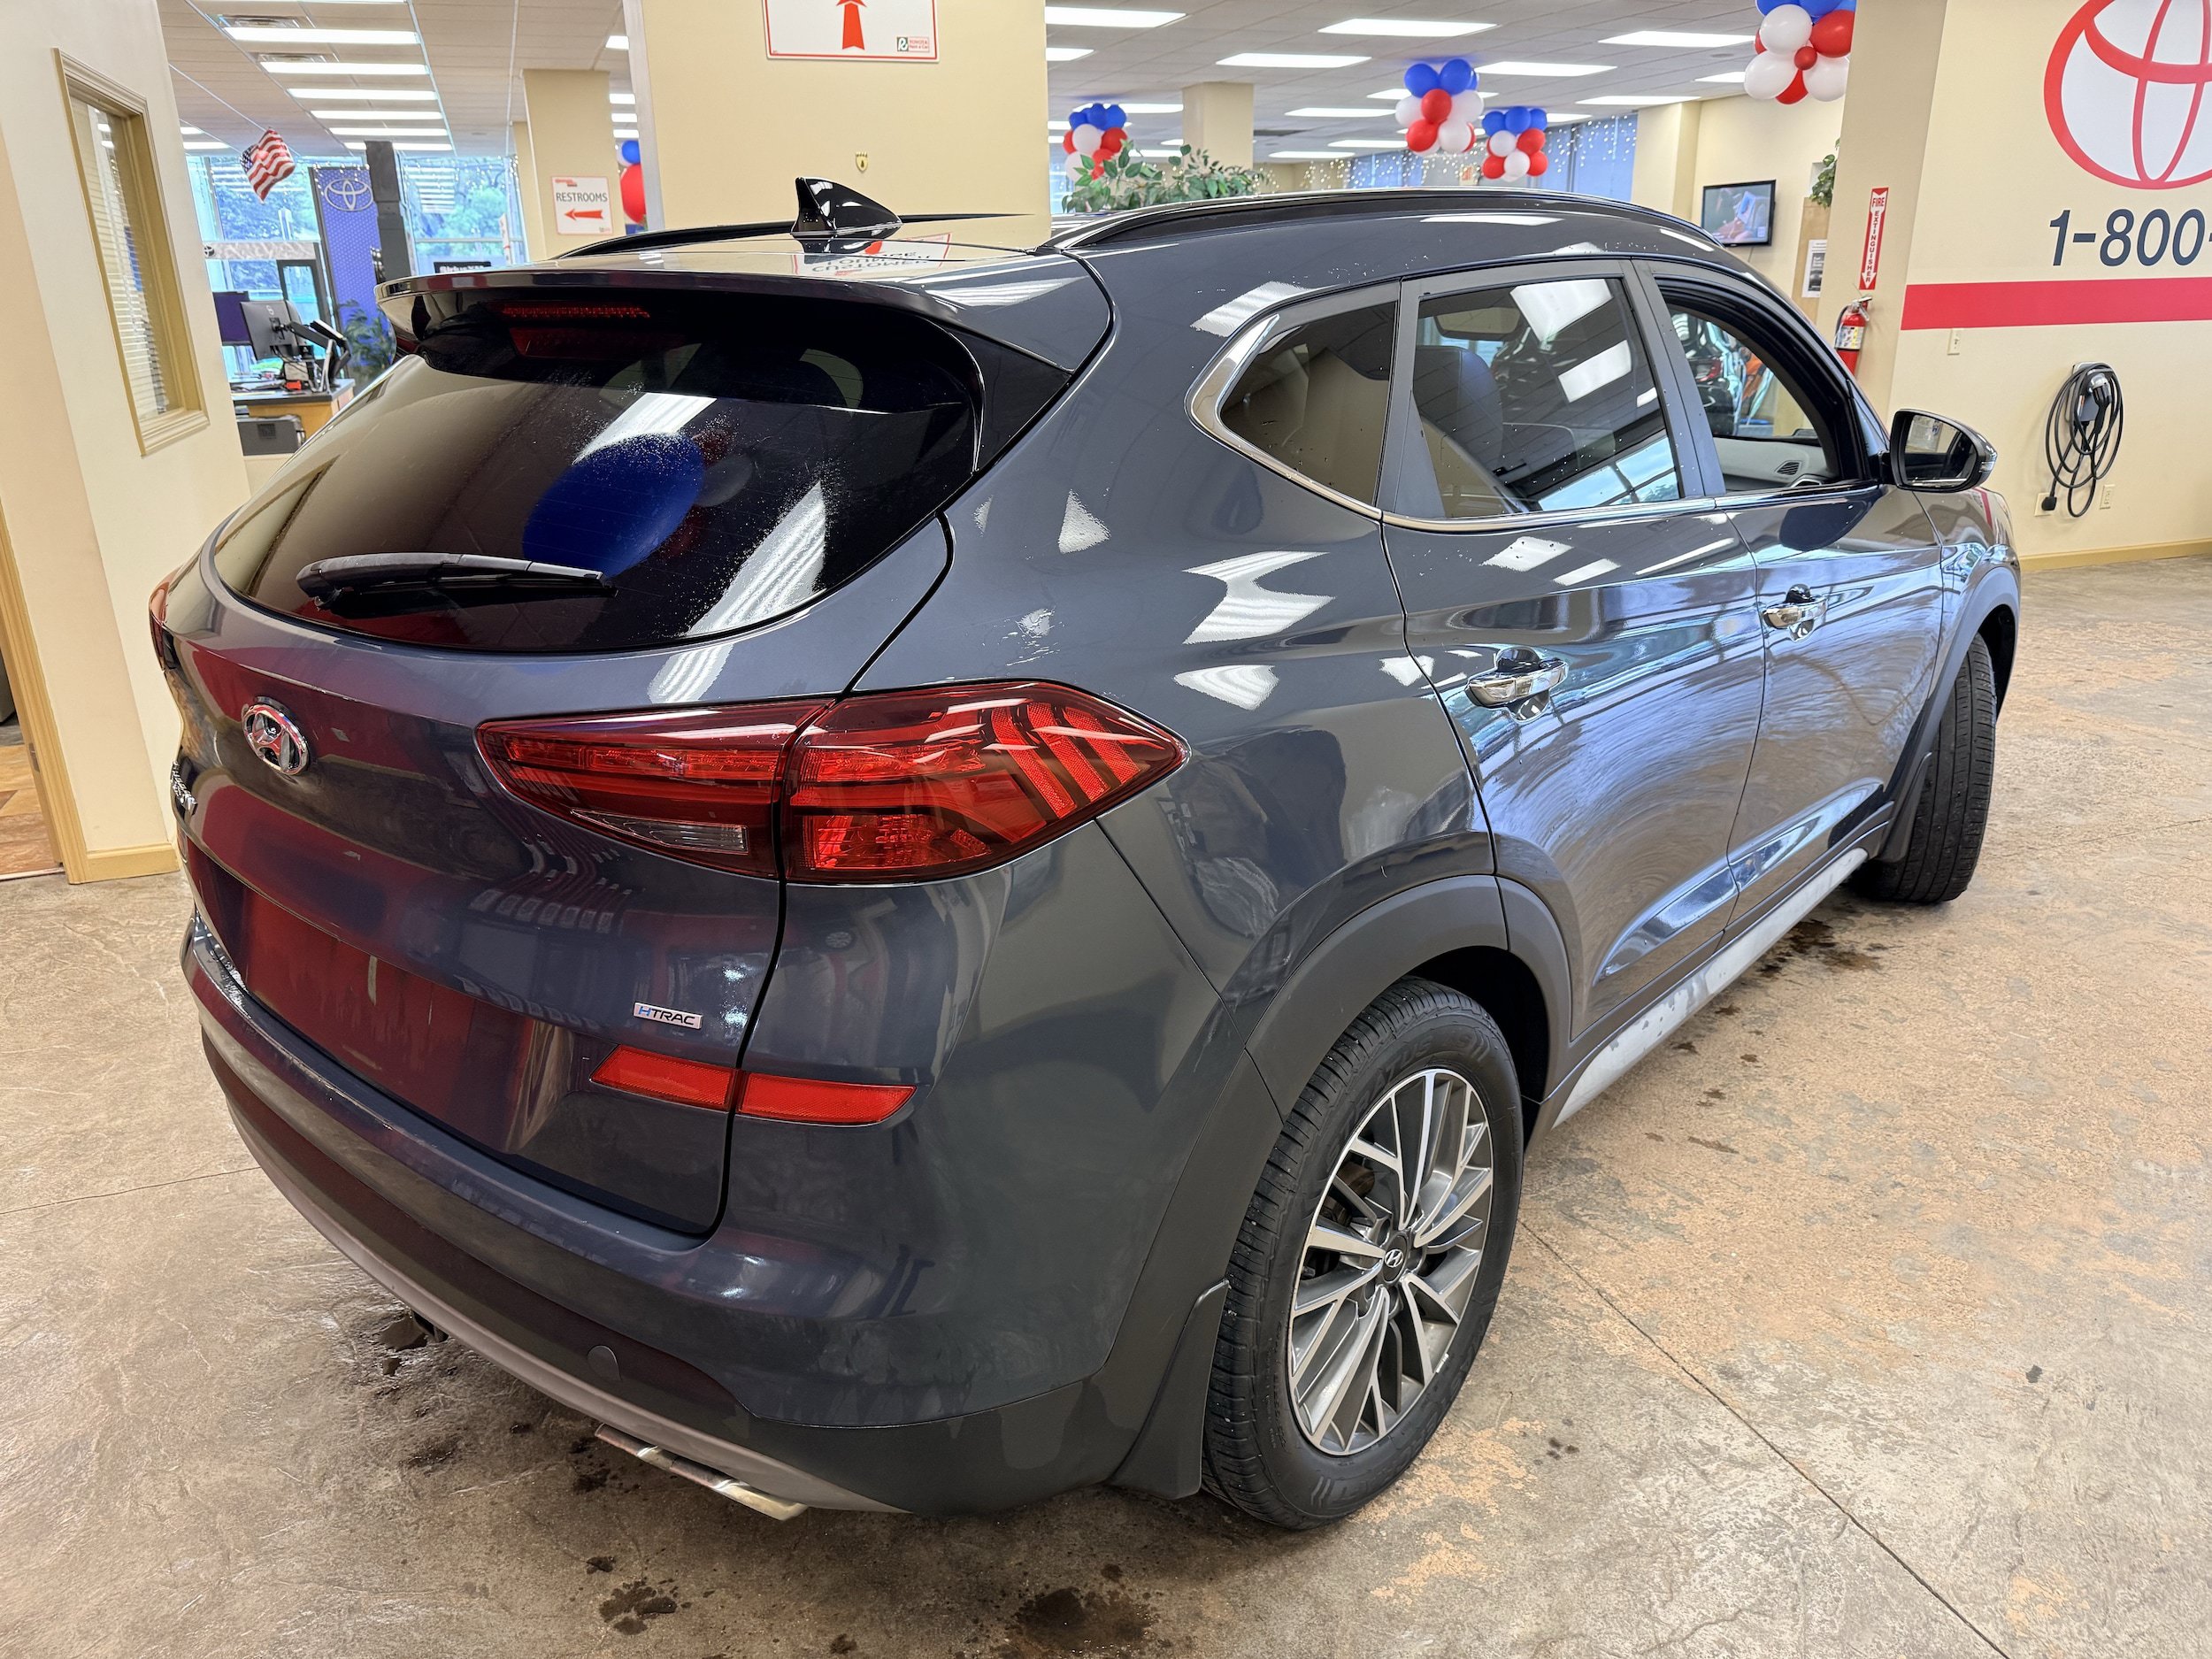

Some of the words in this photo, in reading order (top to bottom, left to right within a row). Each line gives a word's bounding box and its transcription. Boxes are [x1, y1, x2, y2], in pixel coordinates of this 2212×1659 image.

[556, 192, 608, 203] RESTROOMS
[1872, 197, 1885, 207] FIRE
[1865, 211, 1879, 282] EXTINGUISHER
[2049, 208, 2212, 267] 1-800
[638, 1006, 695, 1025] HTRAC
